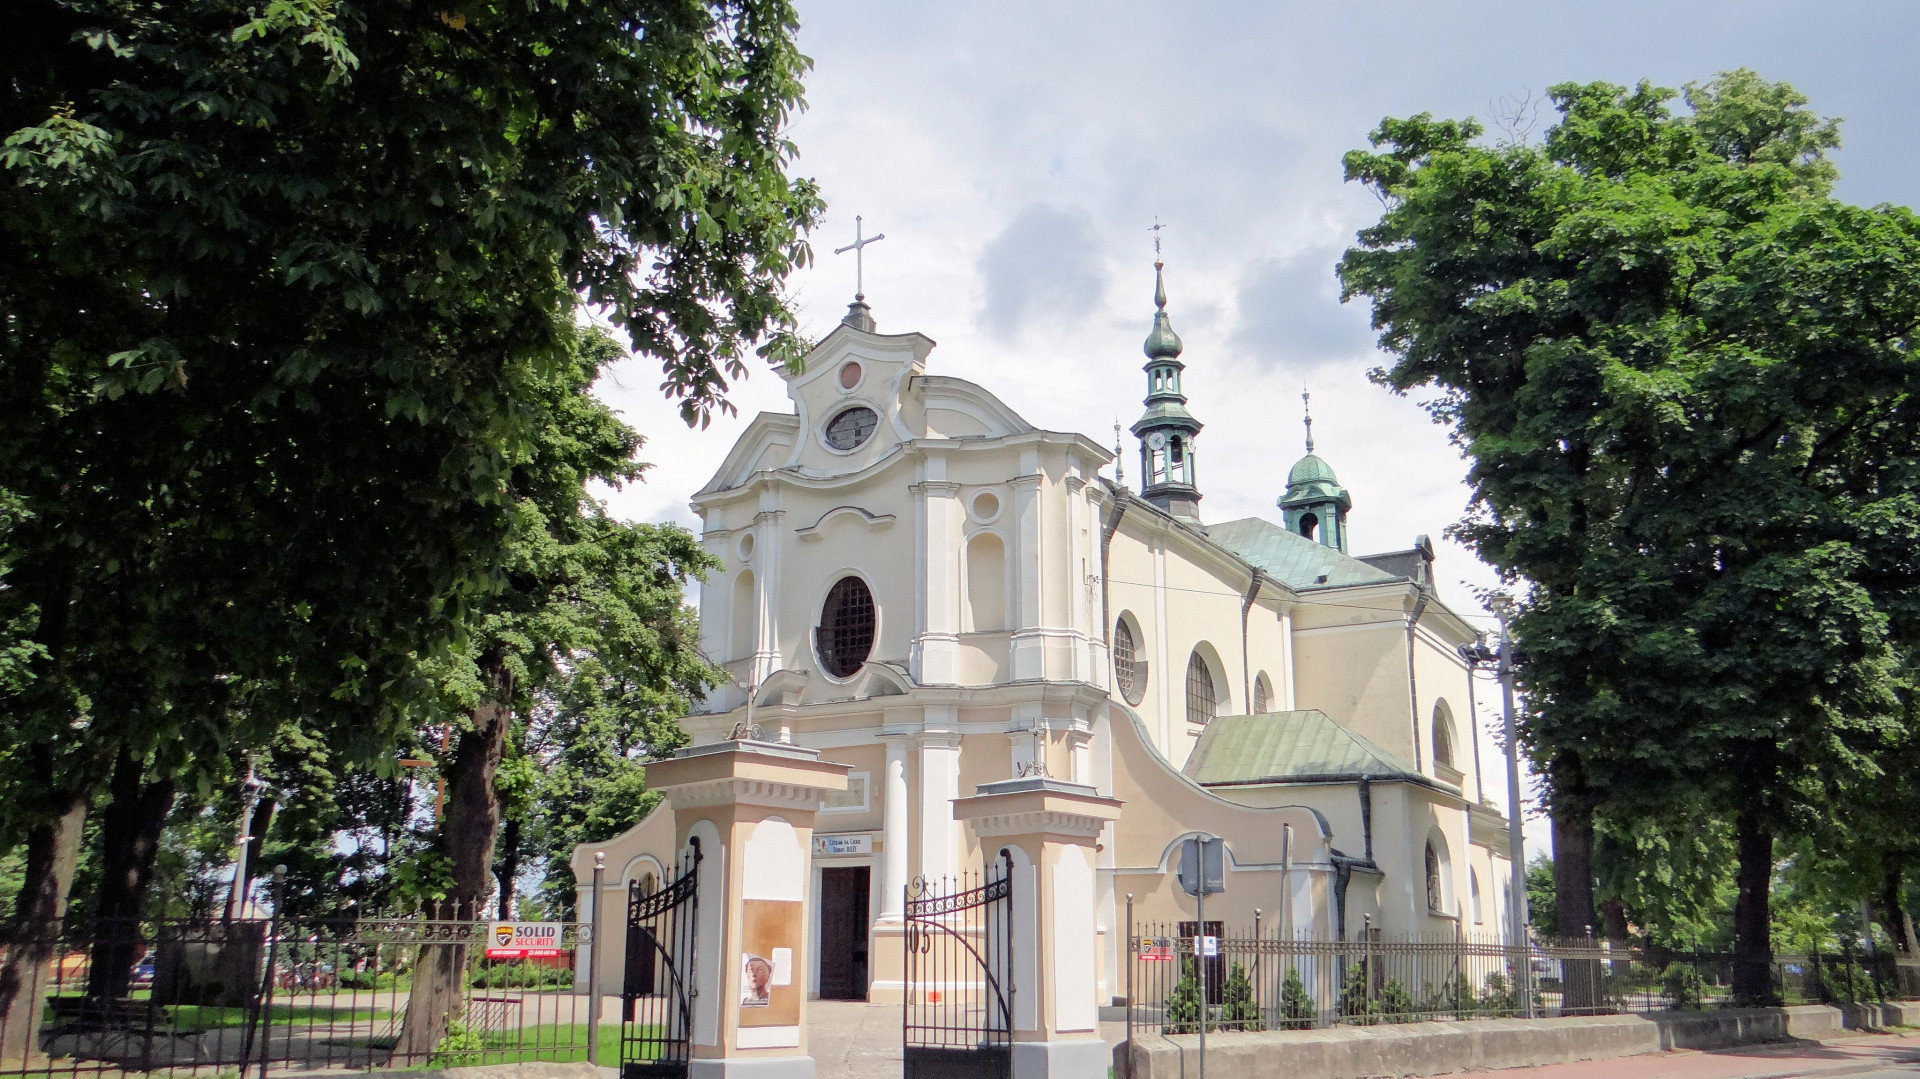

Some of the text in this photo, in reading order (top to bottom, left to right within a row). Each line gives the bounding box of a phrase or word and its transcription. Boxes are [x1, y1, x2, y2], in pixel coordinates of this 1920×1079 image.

[516, 926, 555, 937] SOLID
[515, 937, 555, 946] SECURITY
[1152, 939, 1170, 947] SOLID
